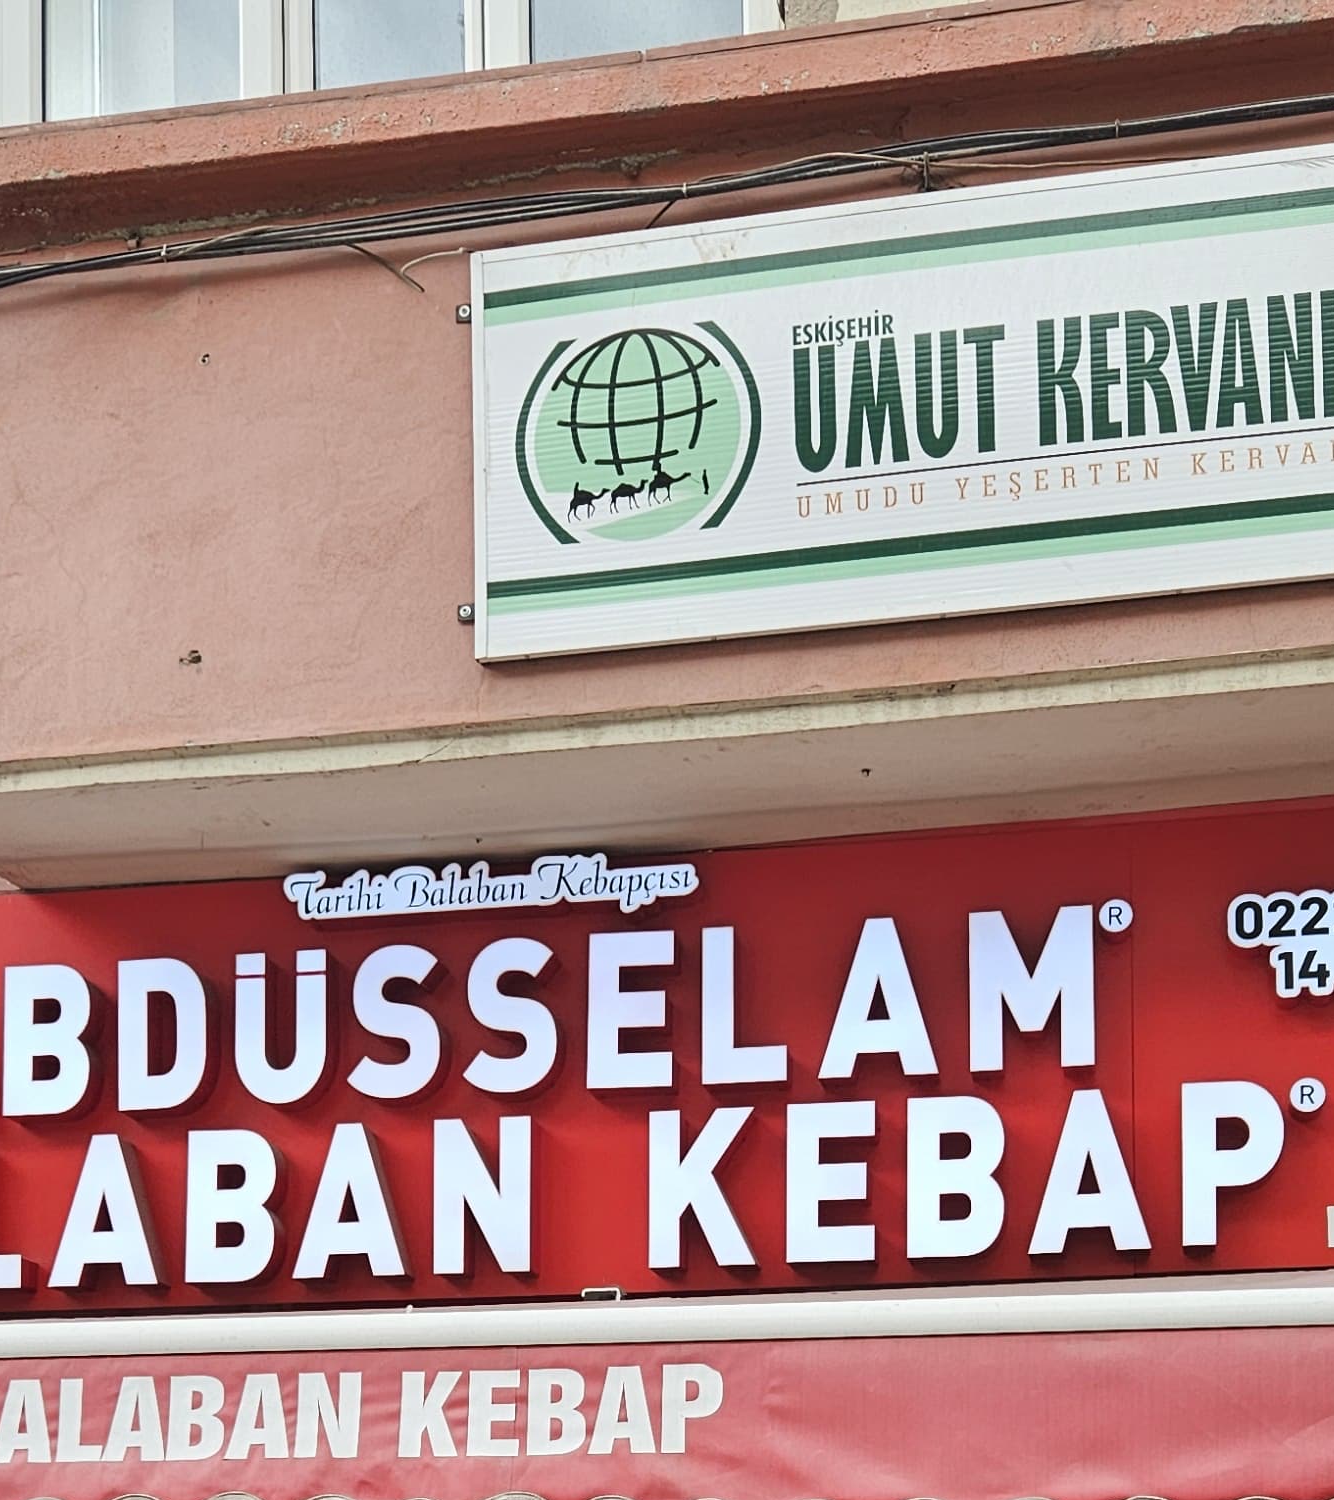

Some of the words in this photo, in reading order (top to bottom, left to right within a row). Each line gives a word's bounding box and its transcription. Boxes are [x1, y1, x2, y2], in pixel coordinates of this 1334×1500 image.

[792, 309, 894, 347] ESKİŞEHİR
[793, 324, 1005, 474] UMUT
[796, 483, 927, 518] UMUDU
[955, 457, 1161, 501] YEŞERTEN
[290, 877, 384, 915] Tarihi
[394, 868, 528, 909] Balaban
[537, 859, 694, 908] Kebapçısı
[1278, 949, 1330, 989] 14
[647, 1080, 1286, 1269] KEBAP
[396, 1363, 724, 1459] KEBAP
